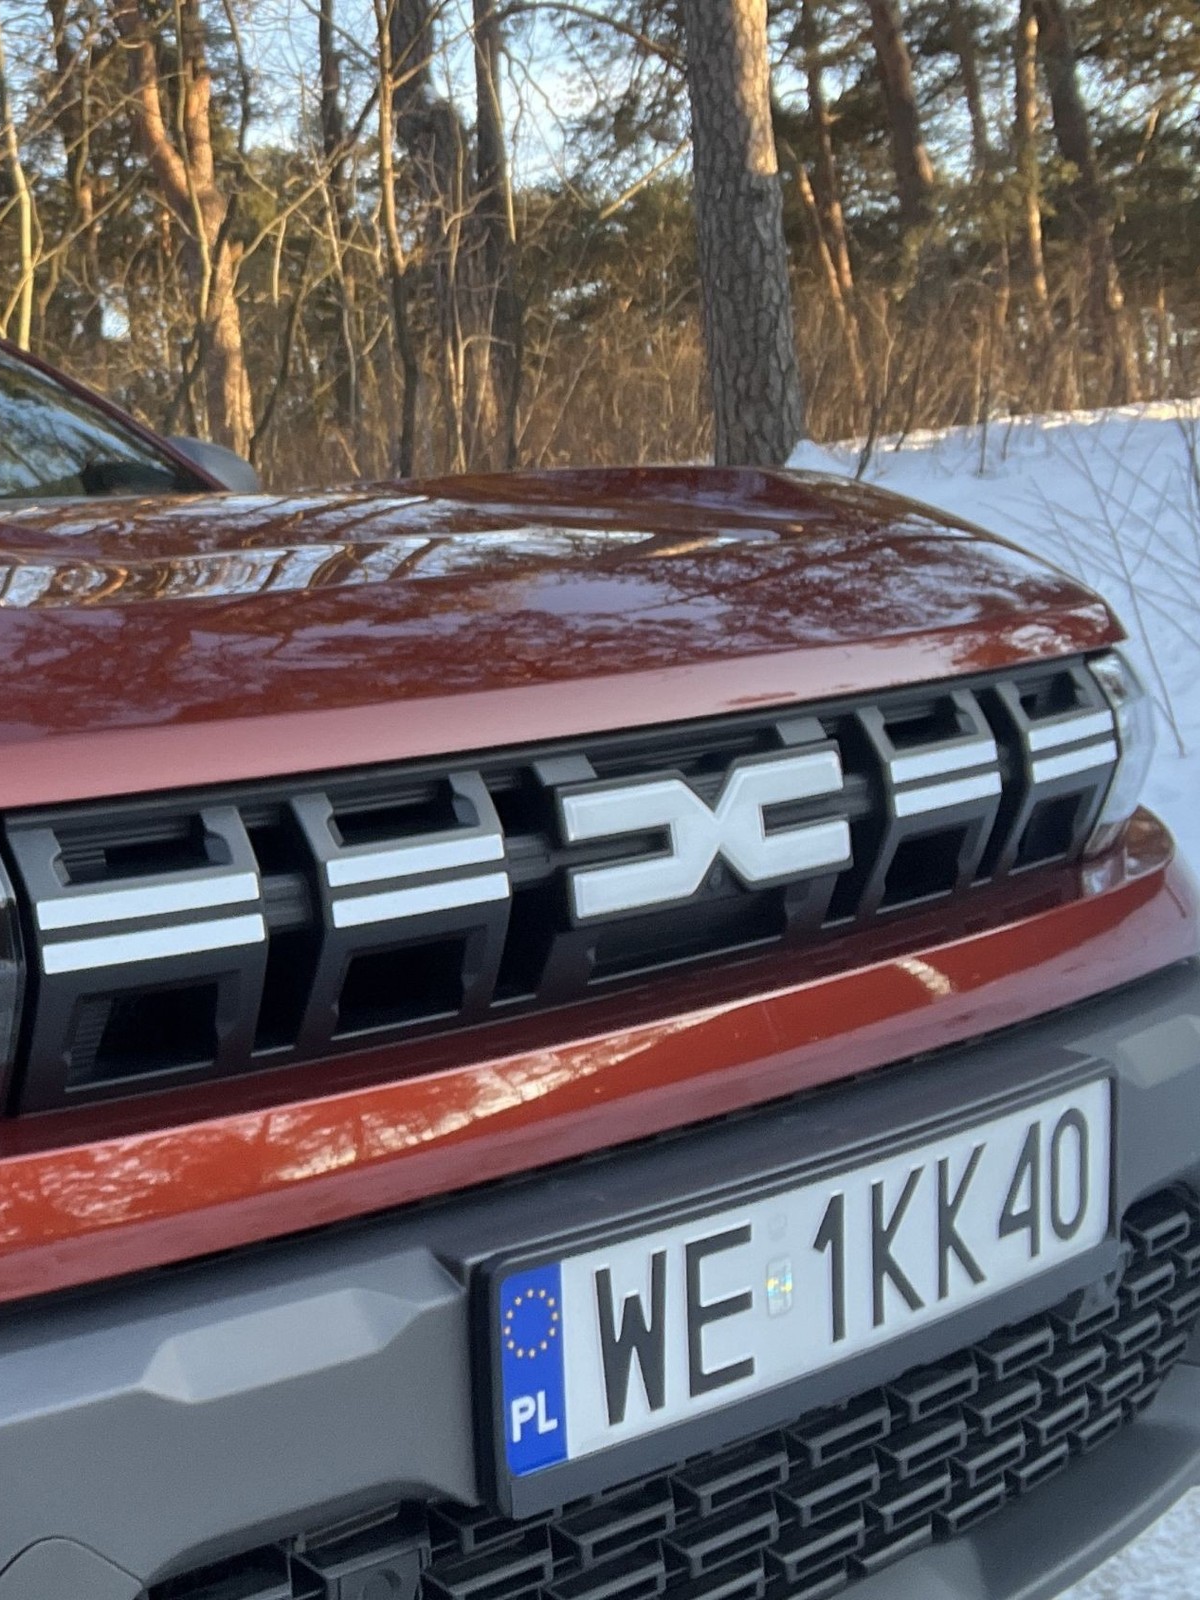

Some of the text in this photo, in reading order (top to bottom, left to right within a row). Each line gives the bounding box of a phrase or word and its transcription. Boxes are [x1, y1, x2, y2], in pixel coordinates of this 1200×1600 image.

[595, 1107, 1090, 1426] WE 1KK40
[511, 1391, 558, 1442] PL
